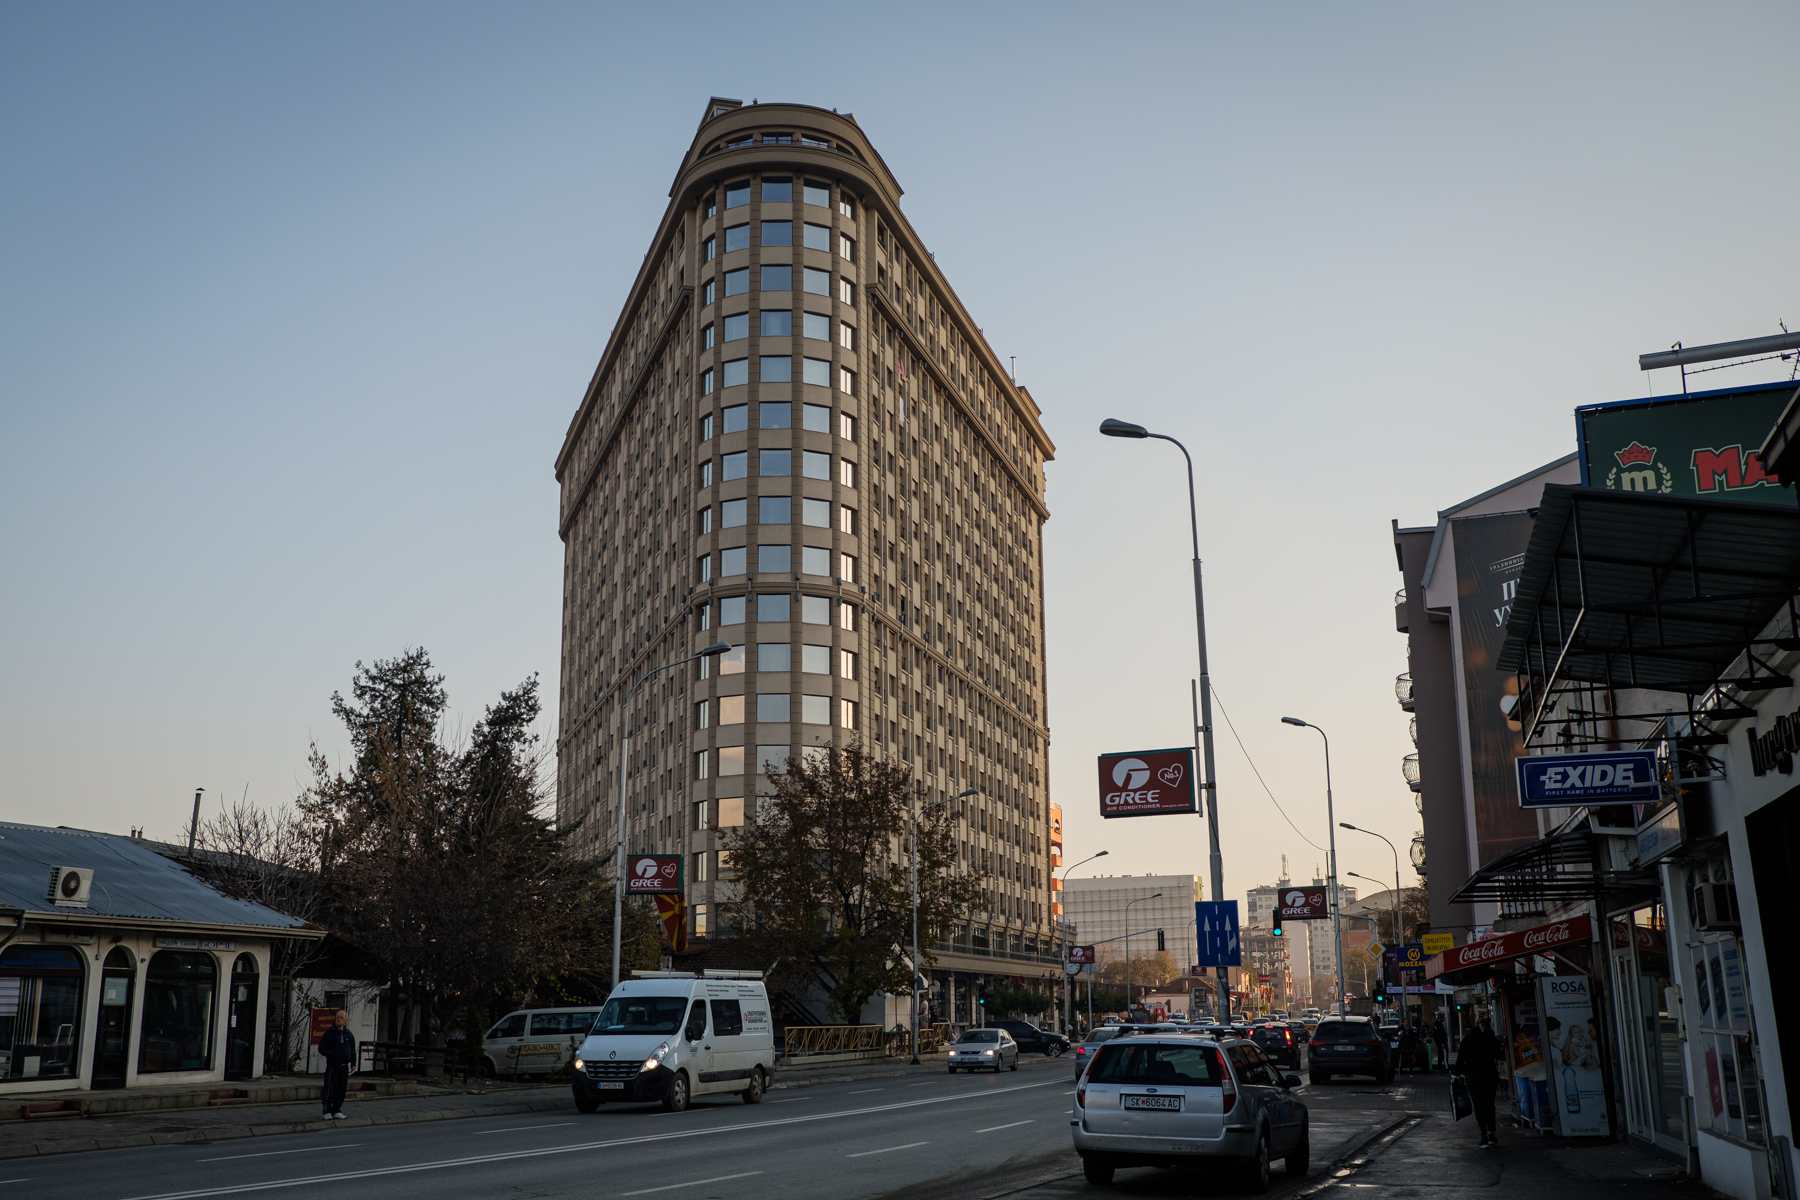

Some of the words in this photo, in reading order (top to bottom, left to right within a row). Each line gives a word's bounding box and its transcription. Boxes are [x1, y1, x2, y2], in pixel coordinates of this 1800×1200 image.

[1540, 763, 1634, 790] EXIDE
[1597, 786, 1632, 794] BATTERIES
[1105, 790, 1160, 805] GREE
[630, 878, 663, 887] GREE
[1282, 906, 1311, 915] GREE
[1523, 922, 1569, 948] Coca-Cola
[1459, 938, 1504, 964] Coca-Cola
[1551, 981, 1586, 993] ROSA
[1130, 1097, 1141, 1107] SK
[1145, 1098, 1166, 1107] 6064
[1167, 1099, 1178, 1108] AC
